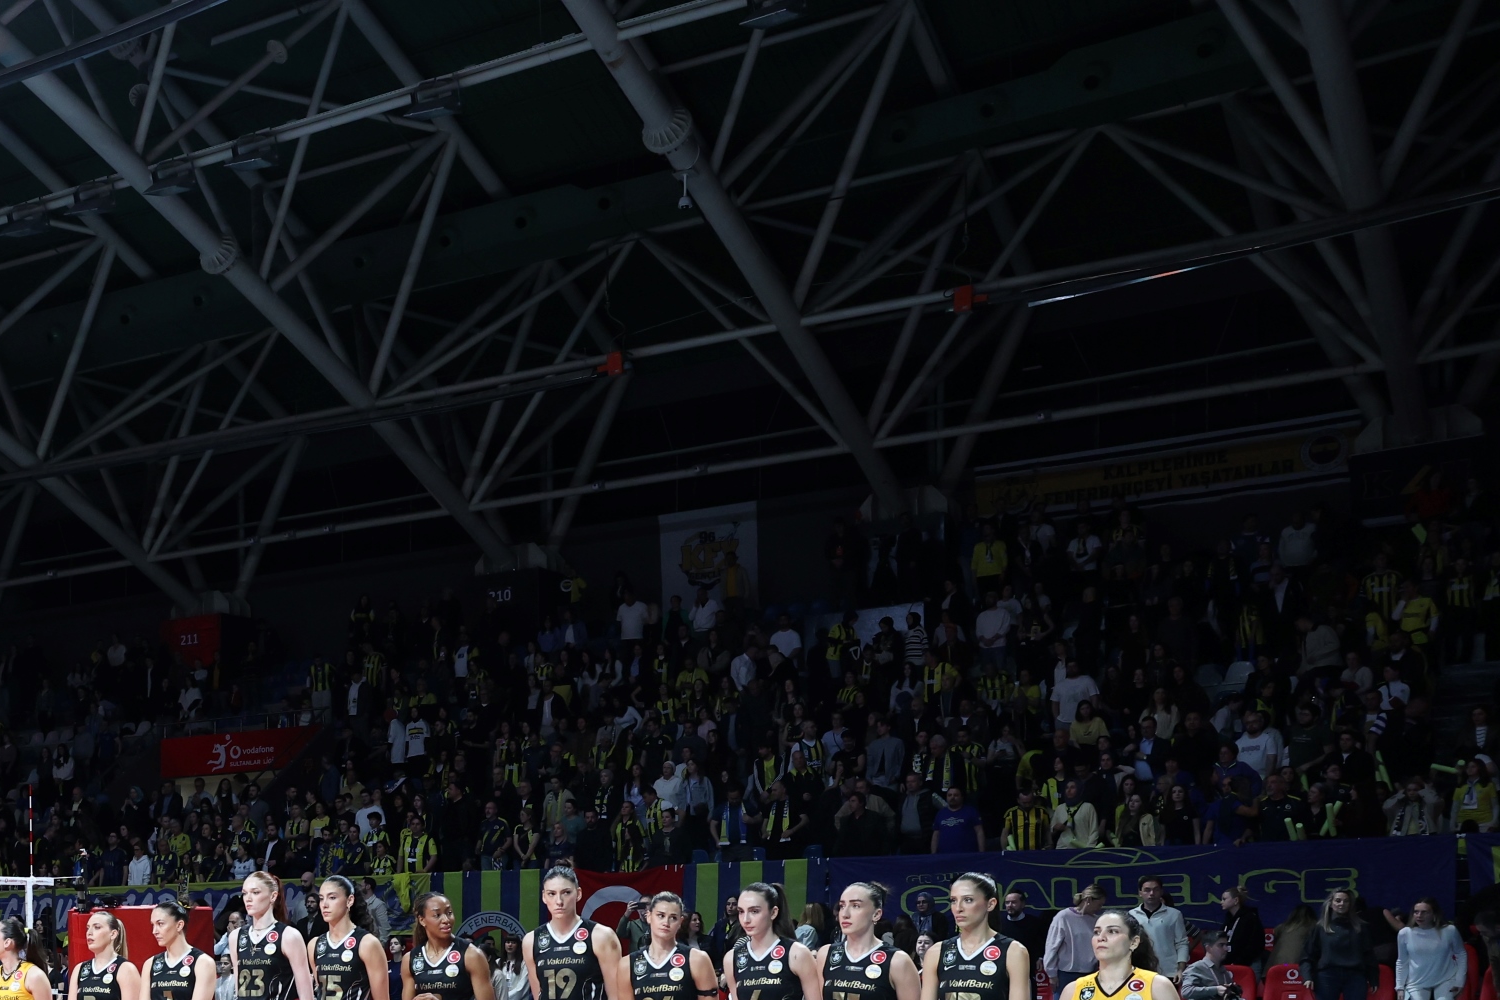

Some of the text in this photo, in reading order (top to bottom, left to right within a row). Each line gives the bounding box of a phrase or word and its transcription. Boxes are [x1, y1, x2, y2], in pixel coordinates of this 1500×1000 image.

[180, 633, 199, 646] 211
[242, 745, 275, 755] vodafone
[229, 759, 261, 767] SULTANLAR
[547, 957, 585, 966] VakıfBank
[238, 969, 265, 997] 23
[544, 967, 577, 1000] 19
[833, 979, 877, 992] VakıfBank
[949, 979, 994, 990] VakıfBank
